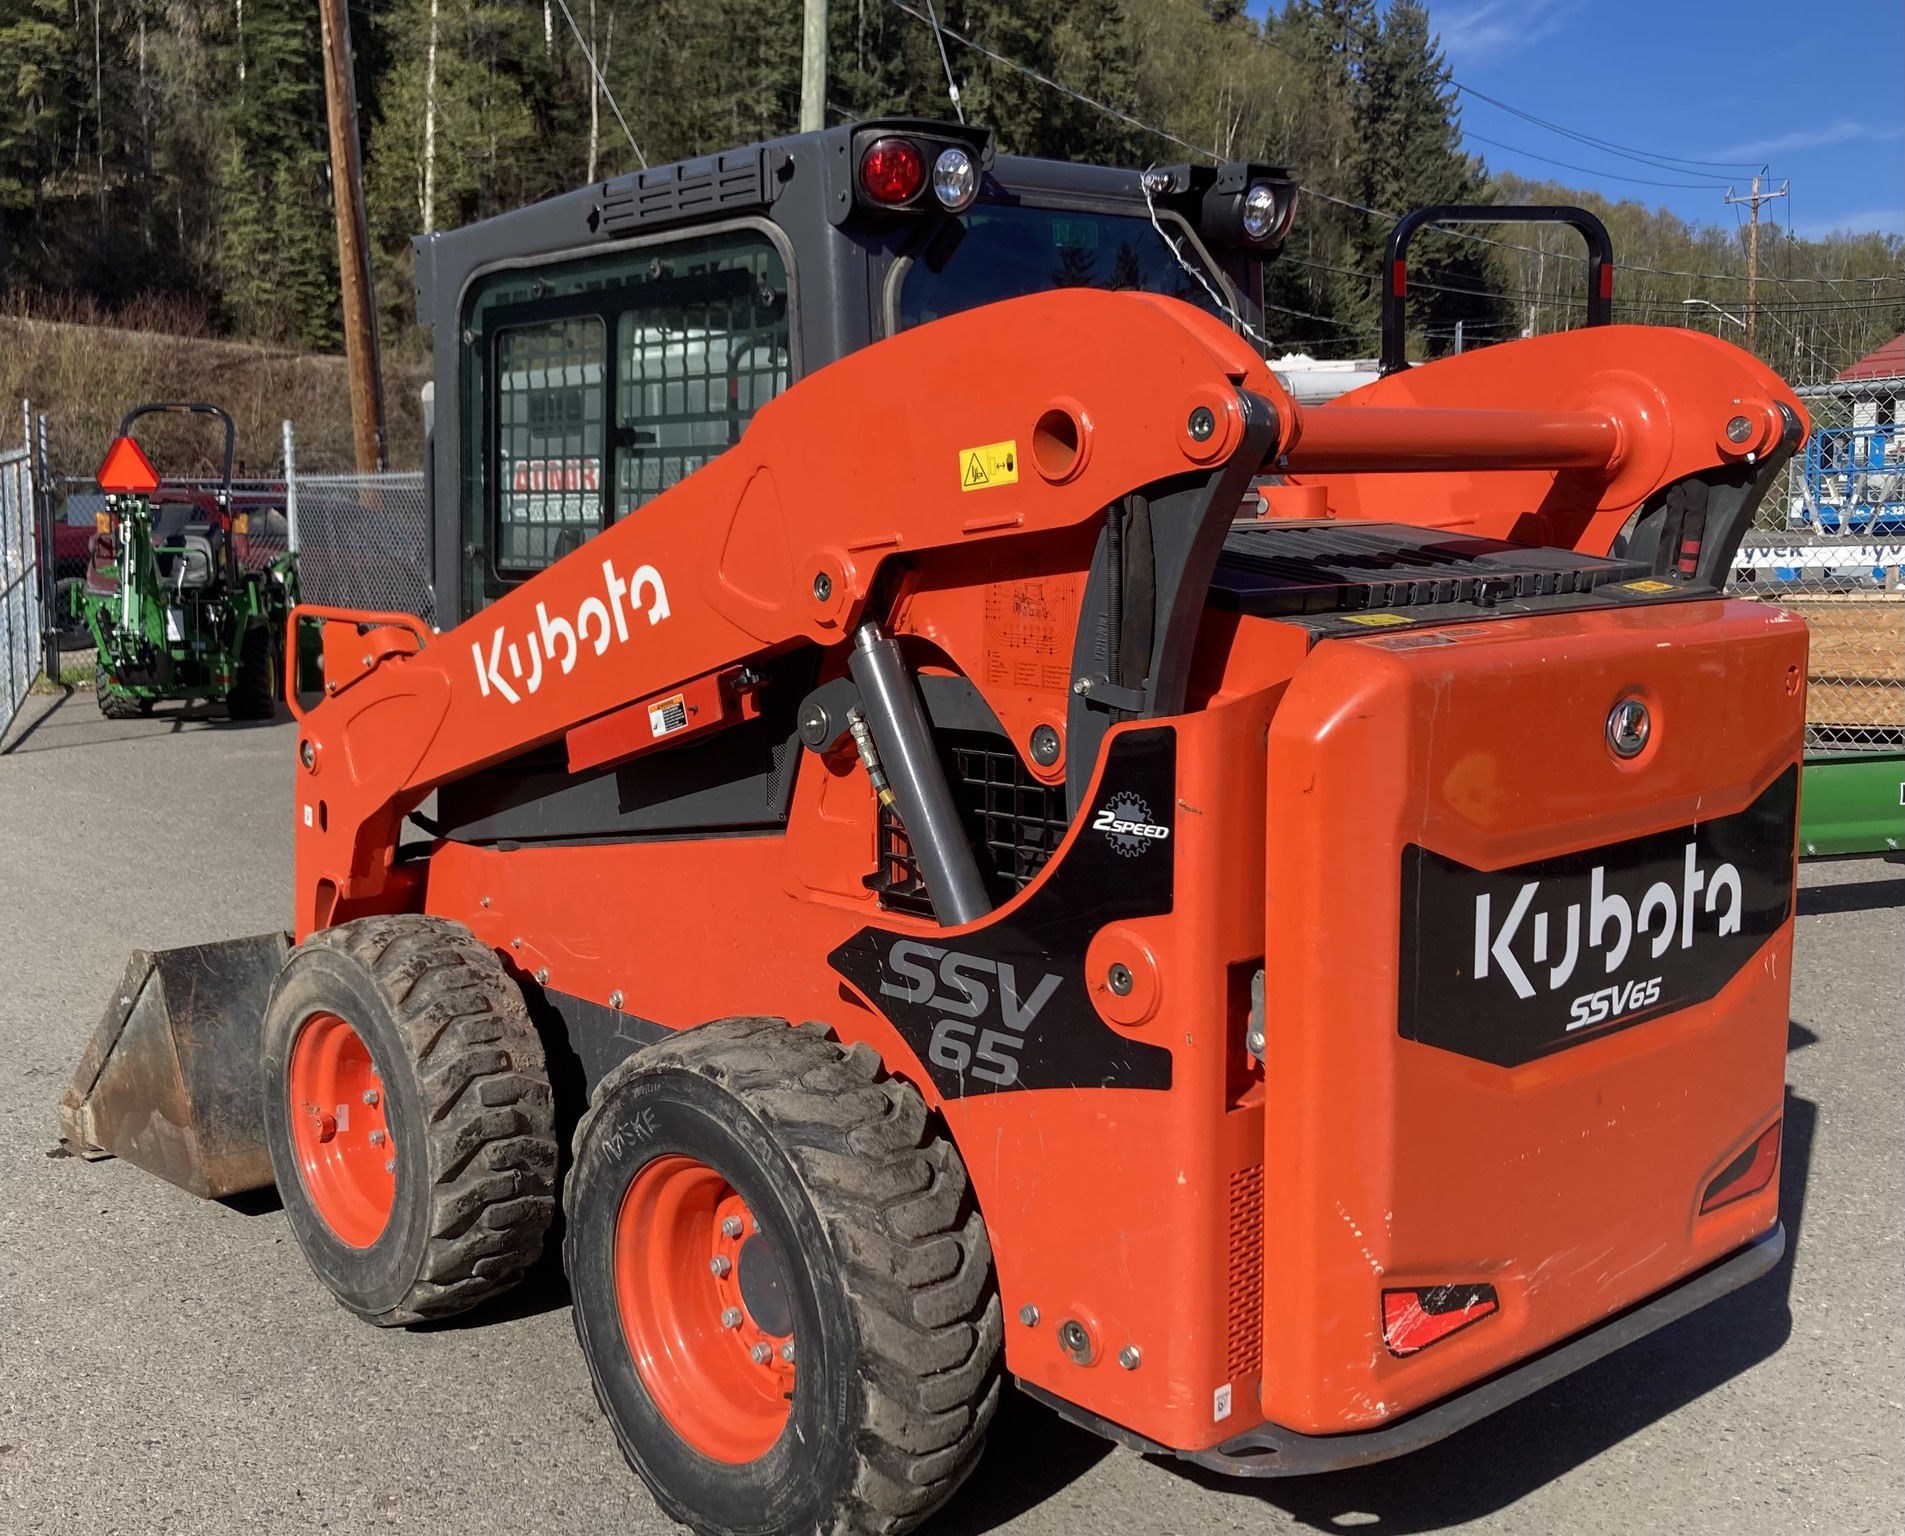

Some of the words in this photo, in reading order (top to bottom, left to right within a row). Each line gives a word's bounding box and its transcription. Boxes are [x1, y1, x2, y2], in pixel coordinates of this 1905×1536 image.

[471, 559, 671, 704] Kubota
[1474, 842, 1742, 999] Kubota
[879, 940, 1064, 1032] SSV
[1565, 976, 1663, 1032] SSV65
[928, 1019, 1026, 1087] 65
